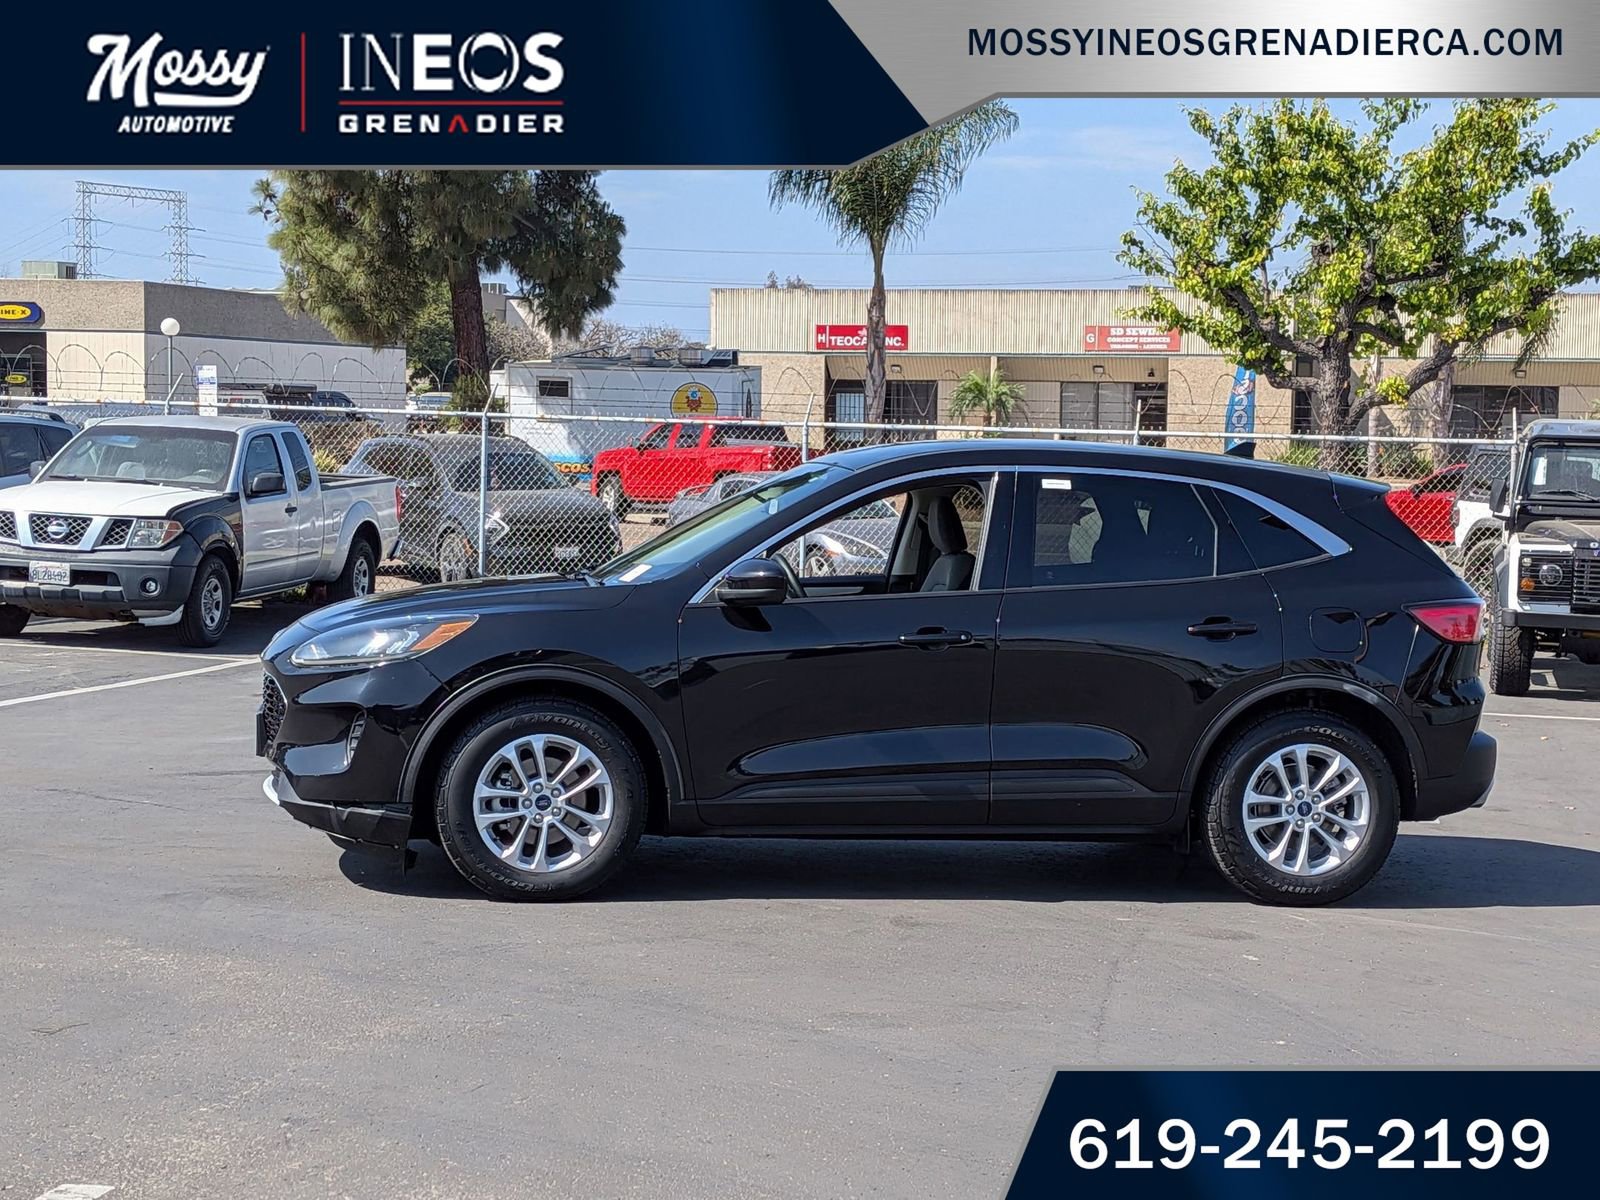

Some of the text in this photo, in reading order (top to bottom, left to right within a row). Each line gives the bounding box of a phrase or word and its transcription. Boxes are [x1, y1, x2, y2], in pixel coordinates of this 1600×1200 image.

[817, 333, 826, 343] H
[829, 336, 905, 347] TEOCA NC.
[1086, 333, 1095, 343] G
